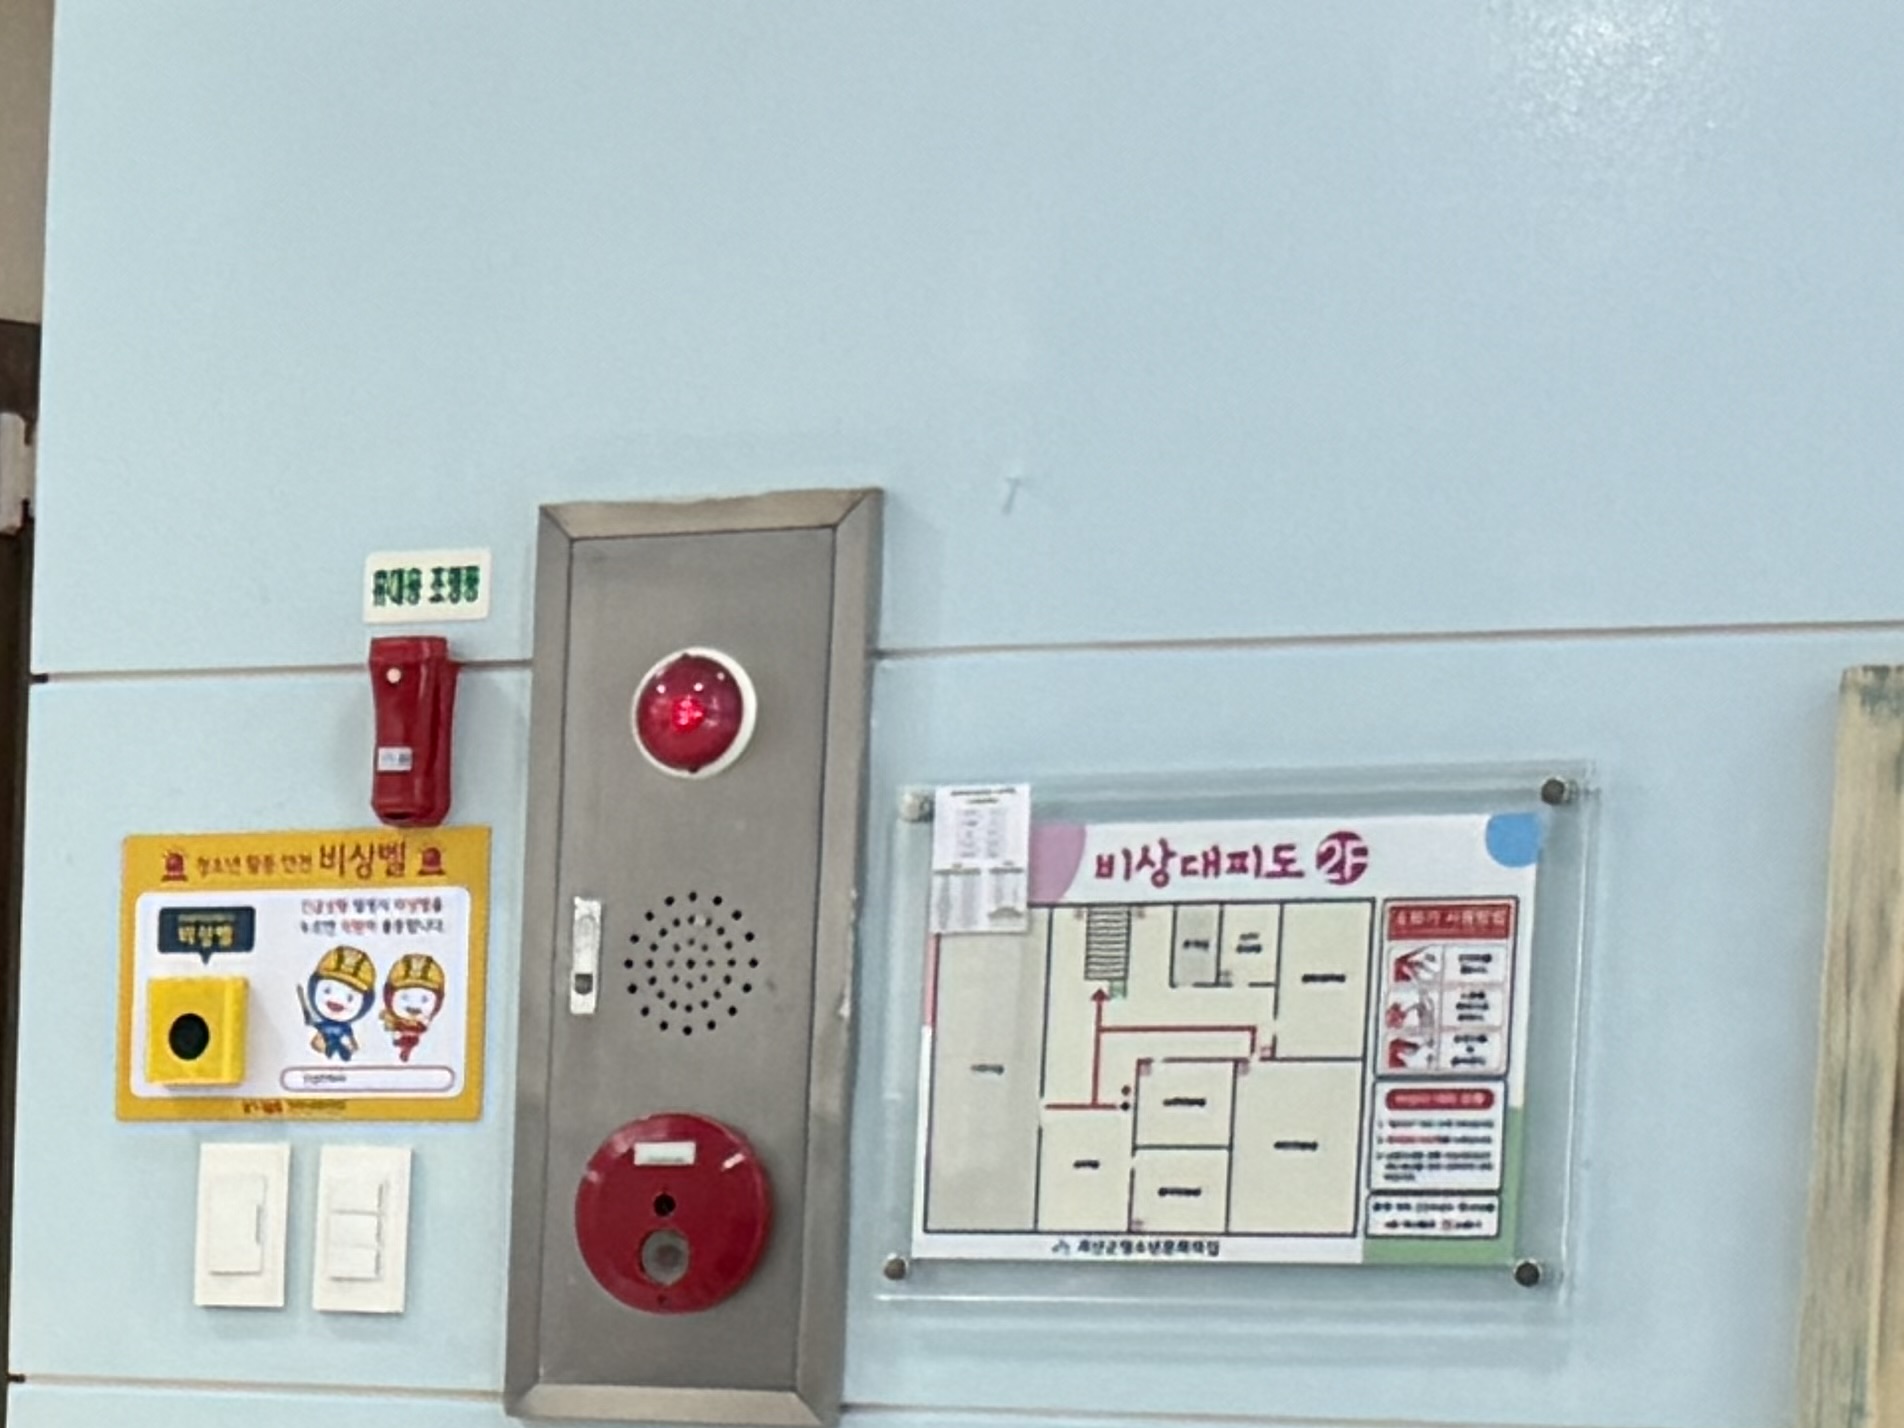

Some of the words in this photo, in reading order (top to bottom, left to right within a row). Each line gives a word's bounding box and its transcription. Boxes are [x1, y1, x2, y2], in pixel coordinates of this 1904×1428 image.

[372, 567, 423, 607] 휴대용
[428, 565, 481, 605] 조명등
[319, 842, 406, 880] 비상벨
[1094, 837, 1305, 888] 비상대피도
